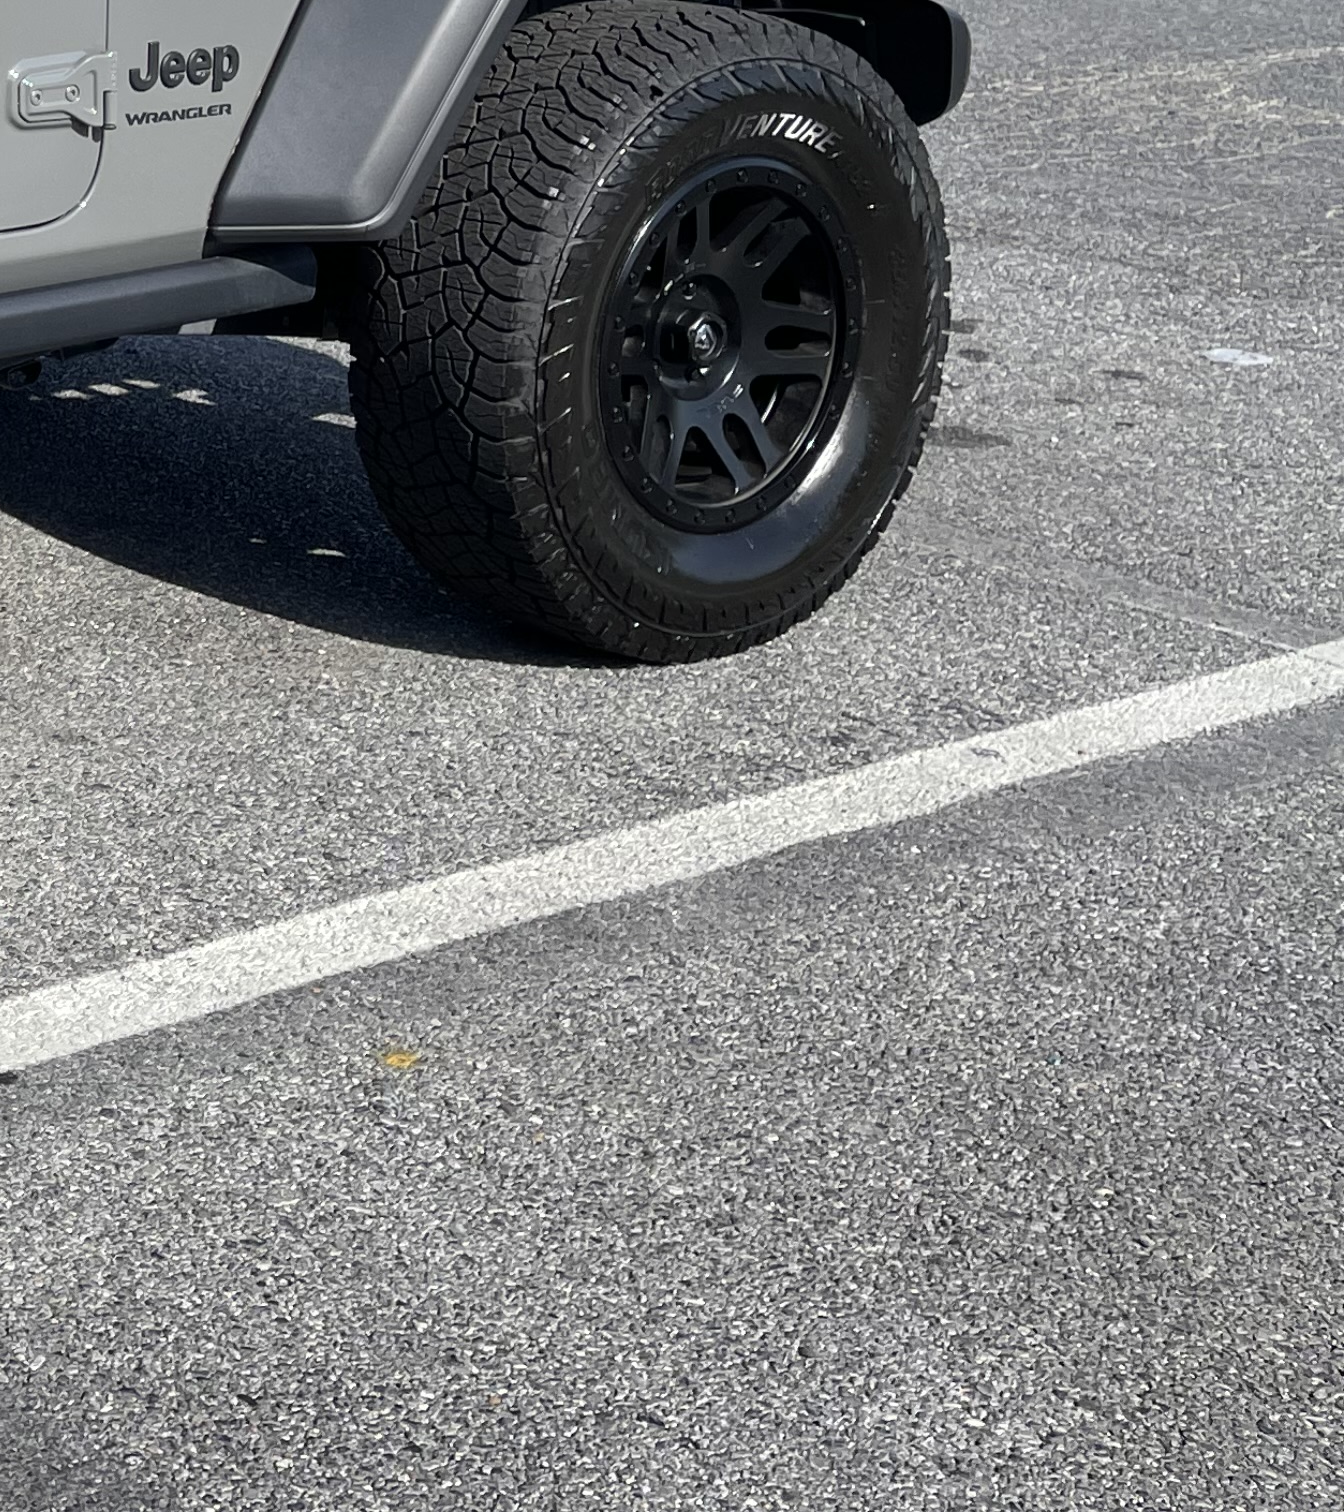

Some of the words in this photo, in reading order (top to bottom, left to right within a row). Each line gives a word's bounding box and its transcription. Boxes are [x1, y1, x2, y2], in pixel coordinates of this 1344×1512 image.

[128, 41, 240, 93] Jeep
[125, 103, 232, 126] WRANGLER
[720, 111, 844, 154] VENTURE
